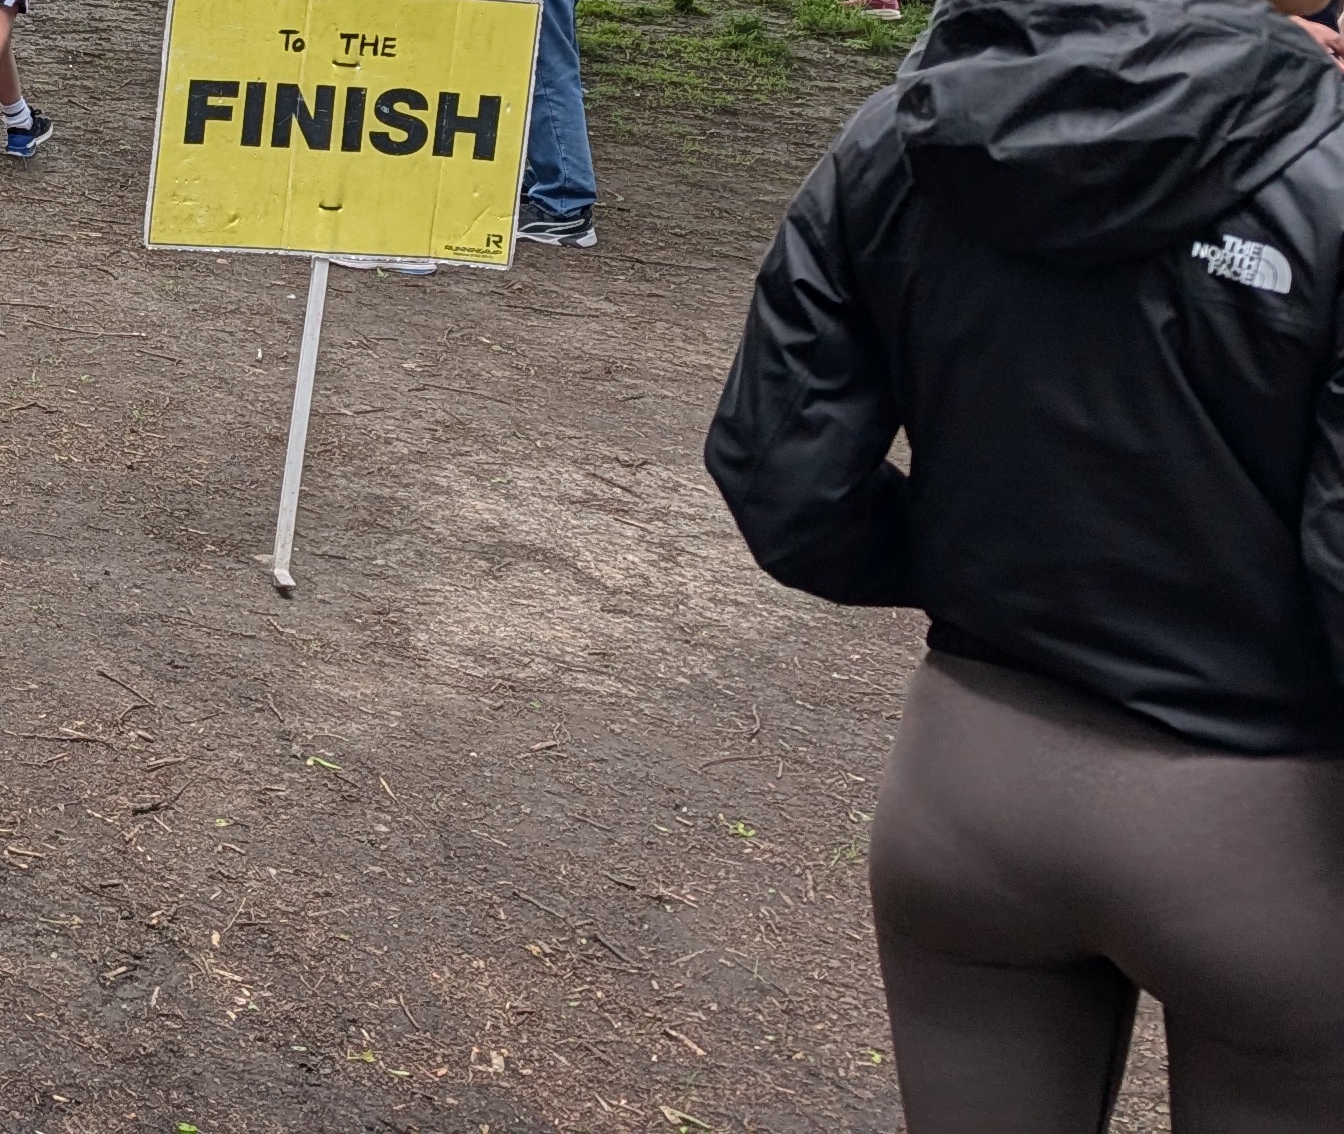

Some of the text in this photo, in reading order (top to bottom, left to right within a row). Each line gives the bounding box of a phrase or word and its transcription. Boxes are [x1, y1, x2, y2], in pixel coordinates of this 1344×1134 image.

[340, 32, 398, 58] THE
[183, 78, 503, 162] FINISH
[1191, 240, 1263, 272] NORTH
[1223, 234, 1264, 257] THE
[1207, 259, 1257, 287] FACE
